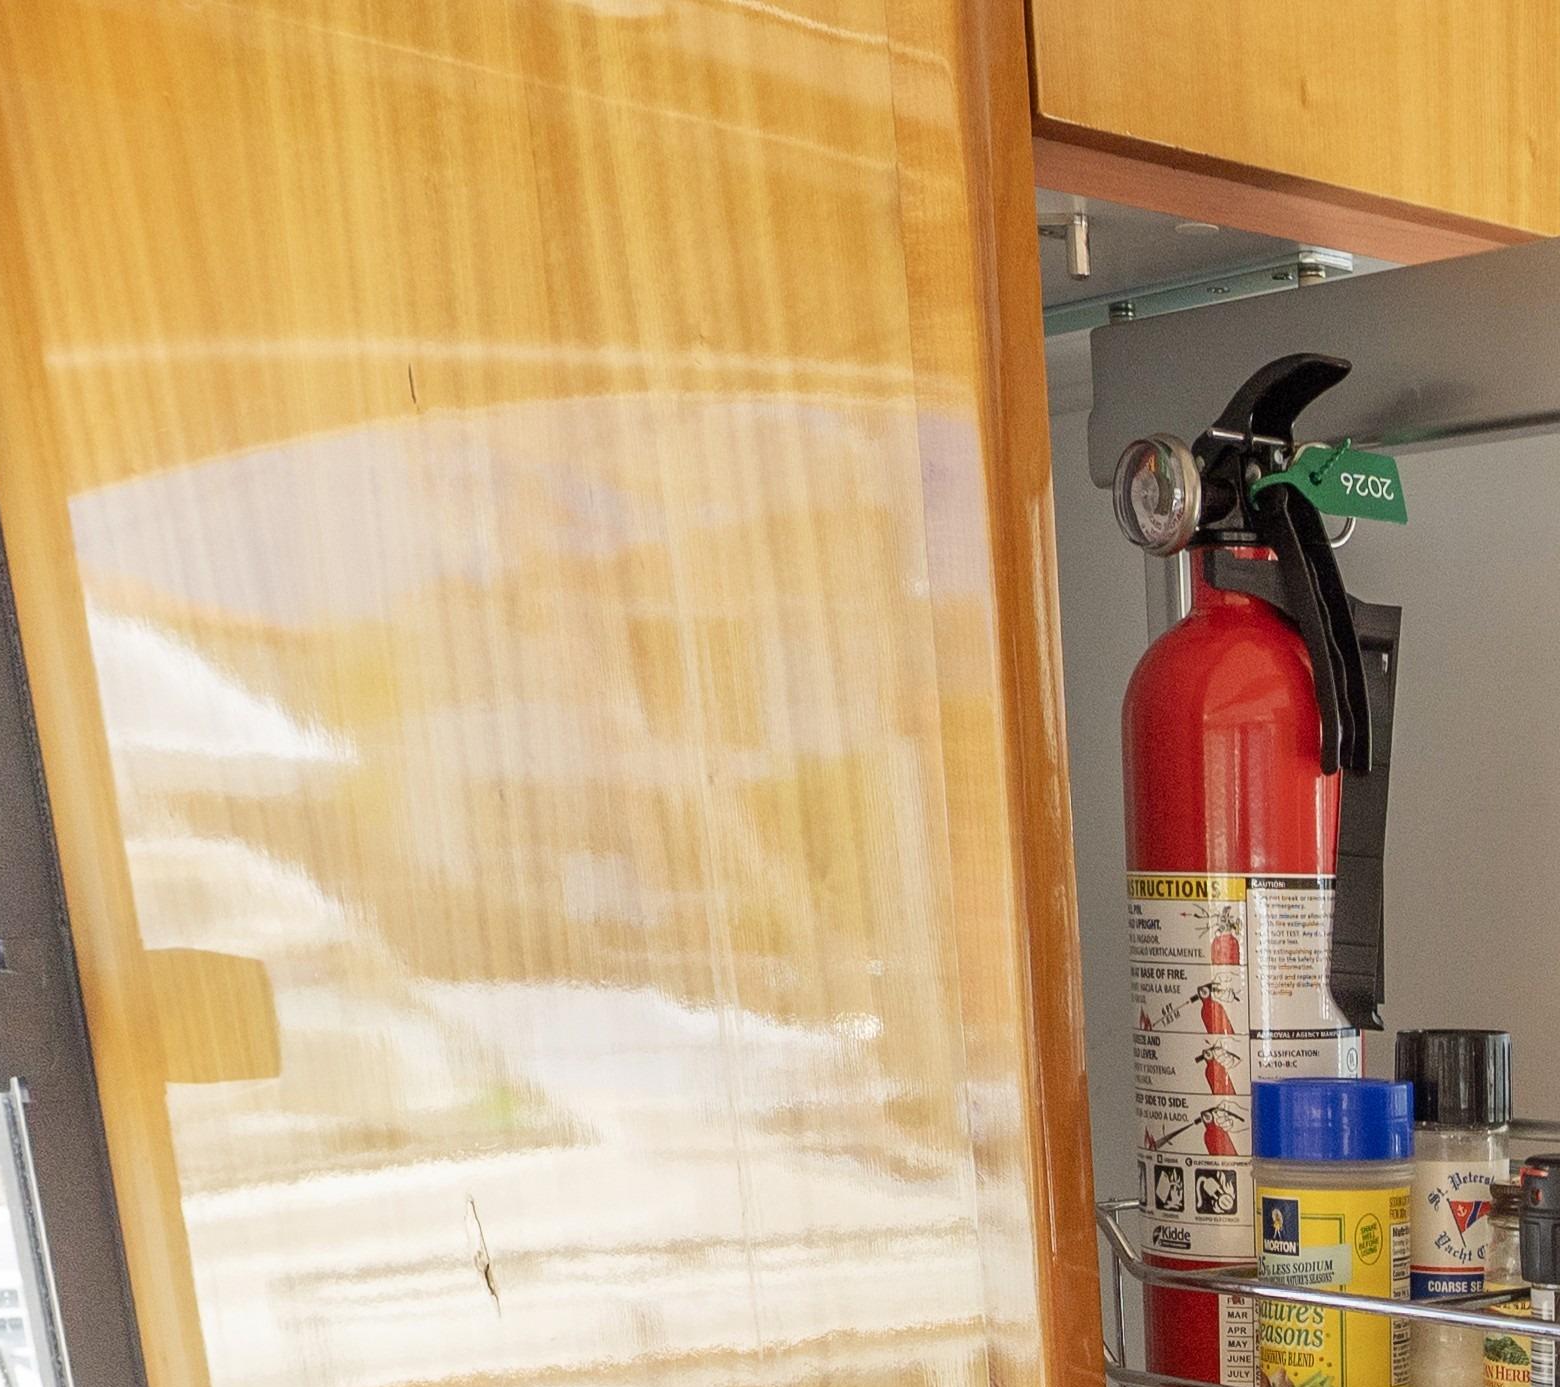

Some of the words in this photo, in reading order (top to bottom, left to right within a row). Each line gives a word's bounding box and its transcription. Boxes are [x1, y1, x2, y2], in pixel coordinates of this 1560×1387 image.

[1340, 472, 1394, 500] 2026
[1166, 970, 1188, 980] FIRE.
[1161, 1225, 1191, 1241] Kidde
[1264, 1239, 1298, 1254] MORTON
[1272, 1264, 1291, 1275] LESS
[1292, 1260, 1333, 1274] SODIUM
[1427, 1280, 1468, 1293] COARSE
[1227, 1311, 1248, 1321] MAR
[1227, 1326, 1247, 1335] APR
[1260, 1324, 1324, 1347] easons
[1228, 1340, 1248, 1349] MAY
[1227, 1354, 1252, 1364] JUNE
[1288, 1351, 1315, 1368] BLEND
[1227, 1369, 1250, 1379] JULY
